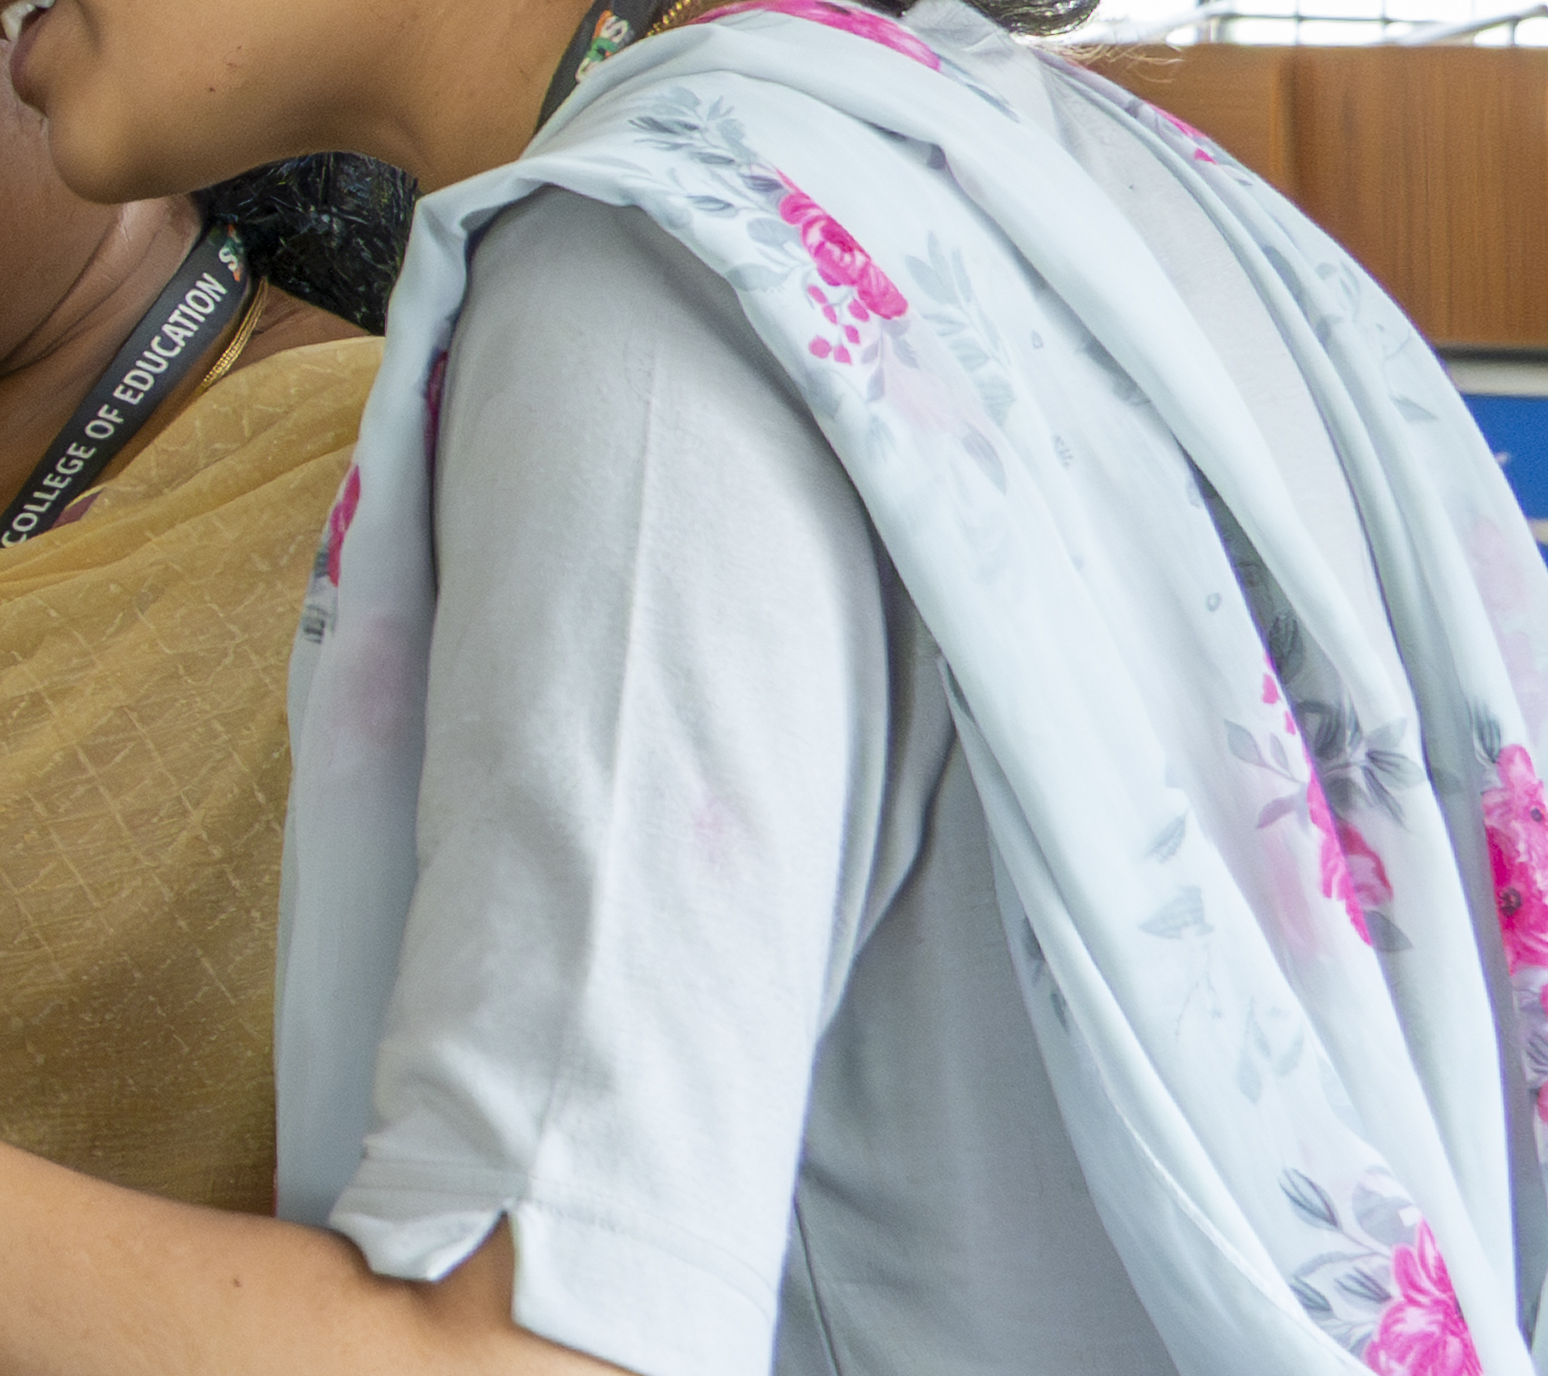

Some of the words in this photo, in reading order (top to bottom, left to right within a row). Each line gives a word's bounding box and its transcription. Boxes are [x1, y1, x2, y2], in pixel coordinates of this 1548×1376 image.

[0, 441, 97, 548] COLLEGE
[84, 404, 125, 440] OF
[112, 272, 227, 407] EDUCATION
